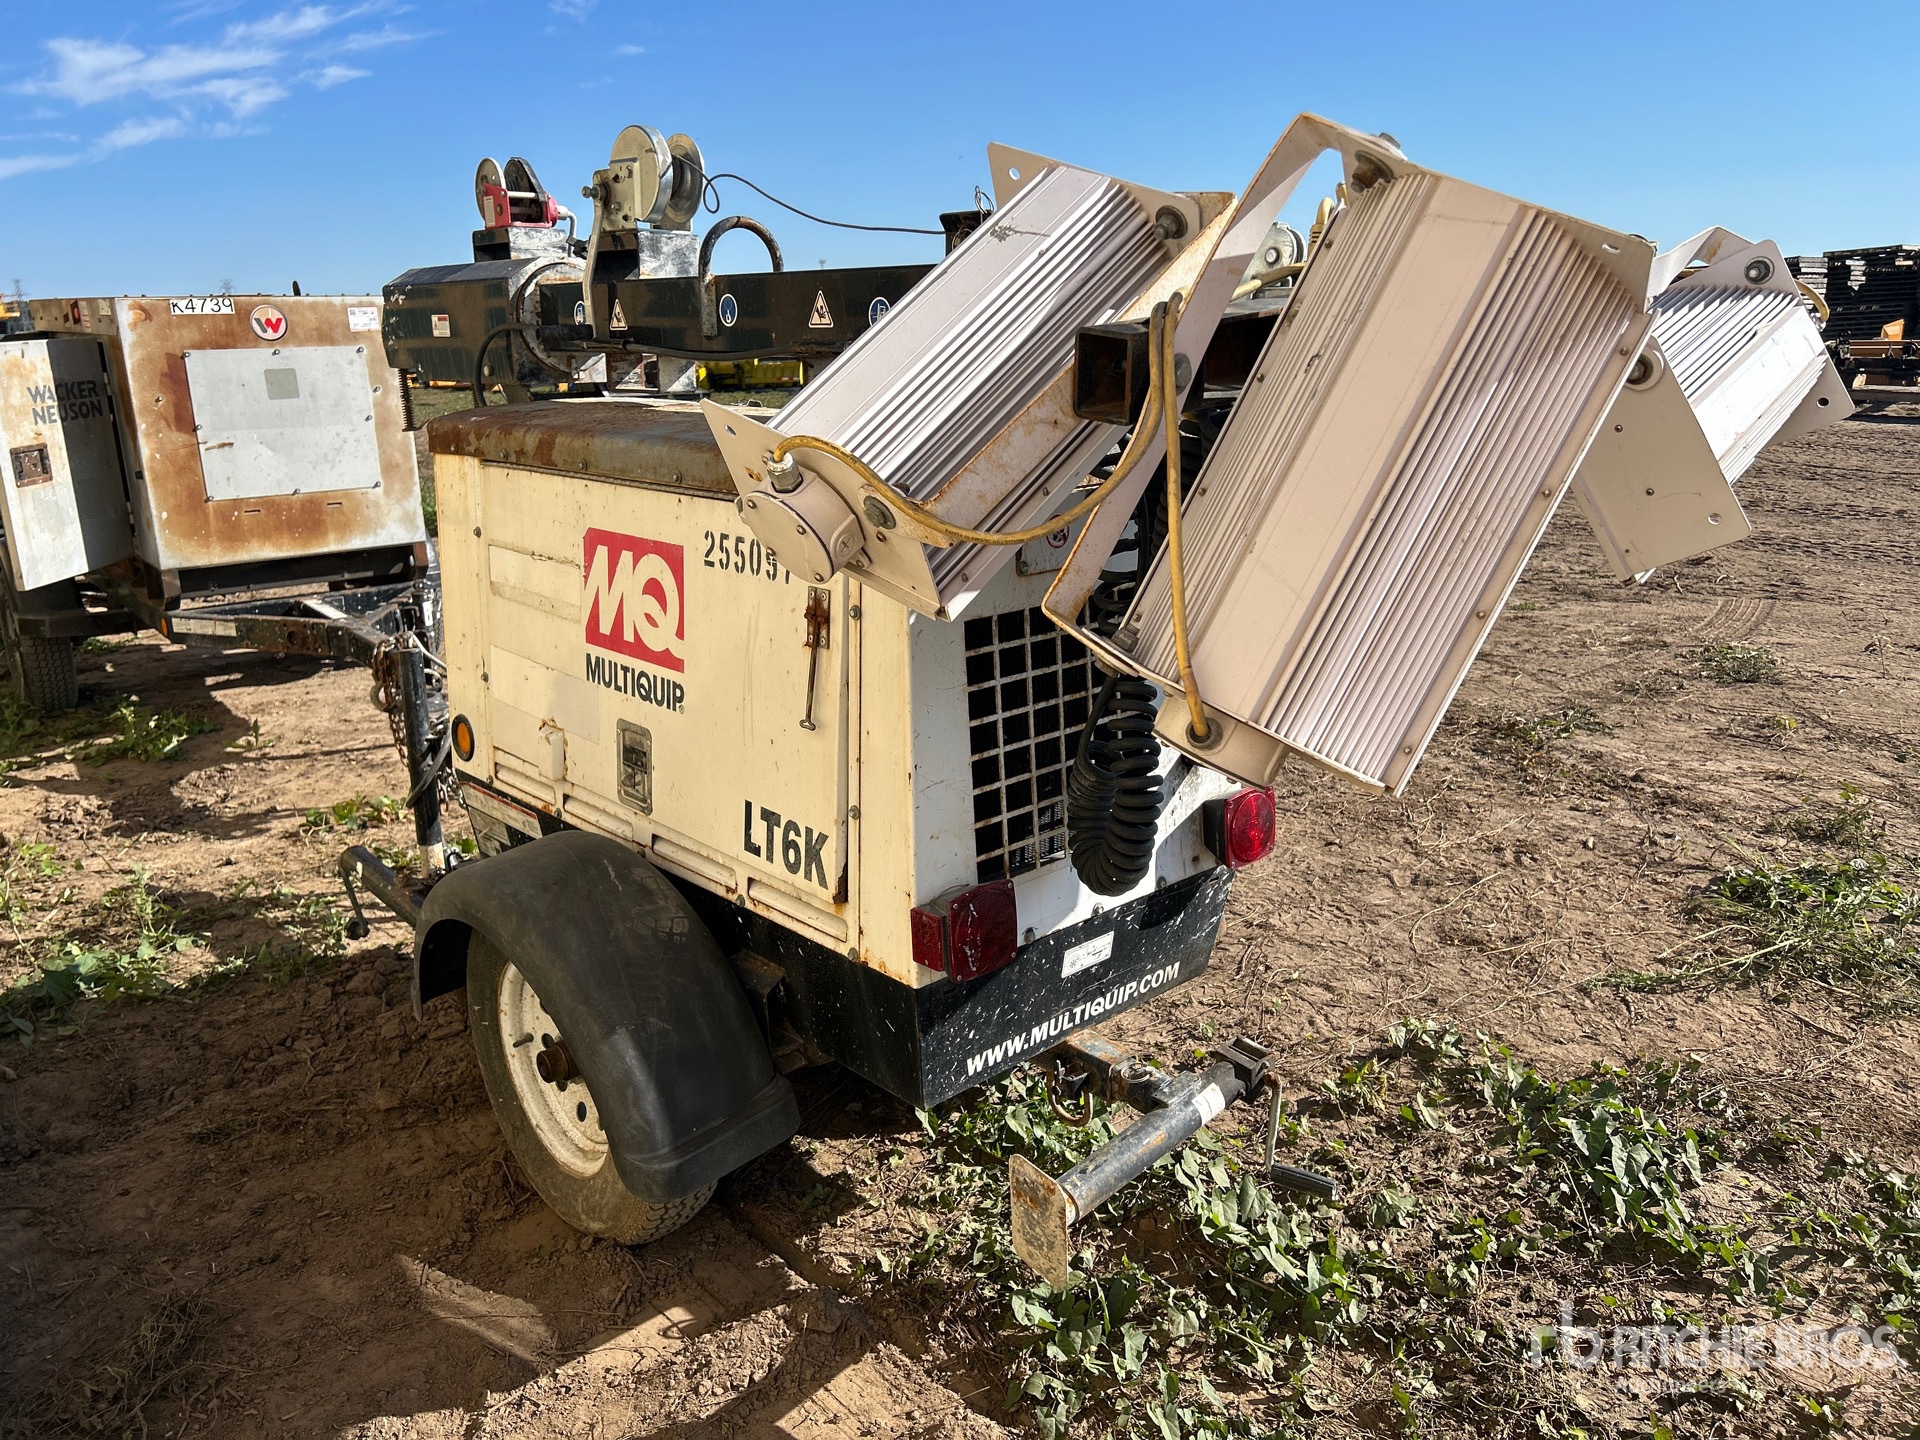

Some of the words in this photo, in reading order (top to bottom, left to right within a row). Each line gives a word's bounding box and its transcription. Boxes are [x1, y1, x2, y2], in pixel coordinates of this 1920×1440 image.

[172, 298, 234, 313] K4739
[26, 380, 100, 404] WACKER
[32, 399, 104, 425] NEUSON
[584, 544, 684, 653] MQ
[743, 799, 829, 890] LT6K
[966, 961, 1181, 1076] WWW.MULTIQUIP.COM
